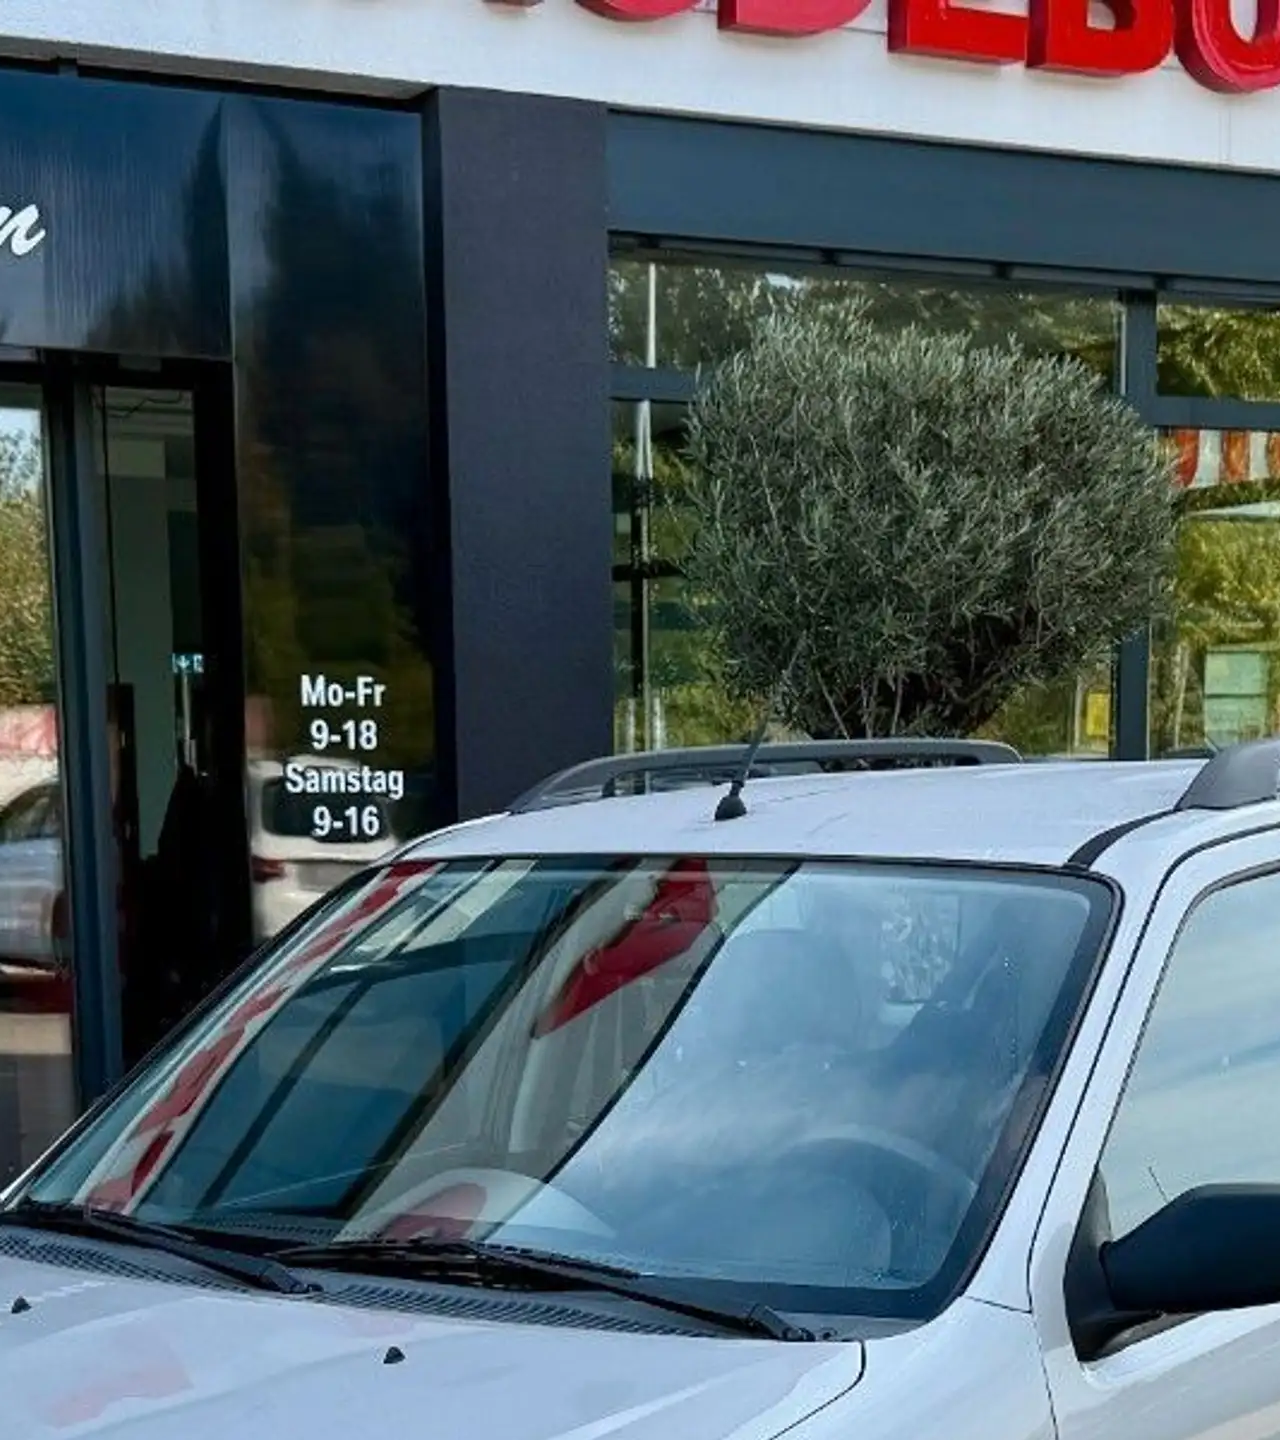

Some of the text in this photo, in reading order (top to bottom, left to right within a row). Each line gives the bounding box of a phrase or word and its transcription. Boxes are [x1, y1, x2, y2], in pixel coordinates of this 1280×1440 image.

[300, 674, 387, 707] Mo-Fr
[310, 720, 378, 750] 9-18
[284, 763, 405, 800] Samstag
[312, 804, 381, 837] 9-16
